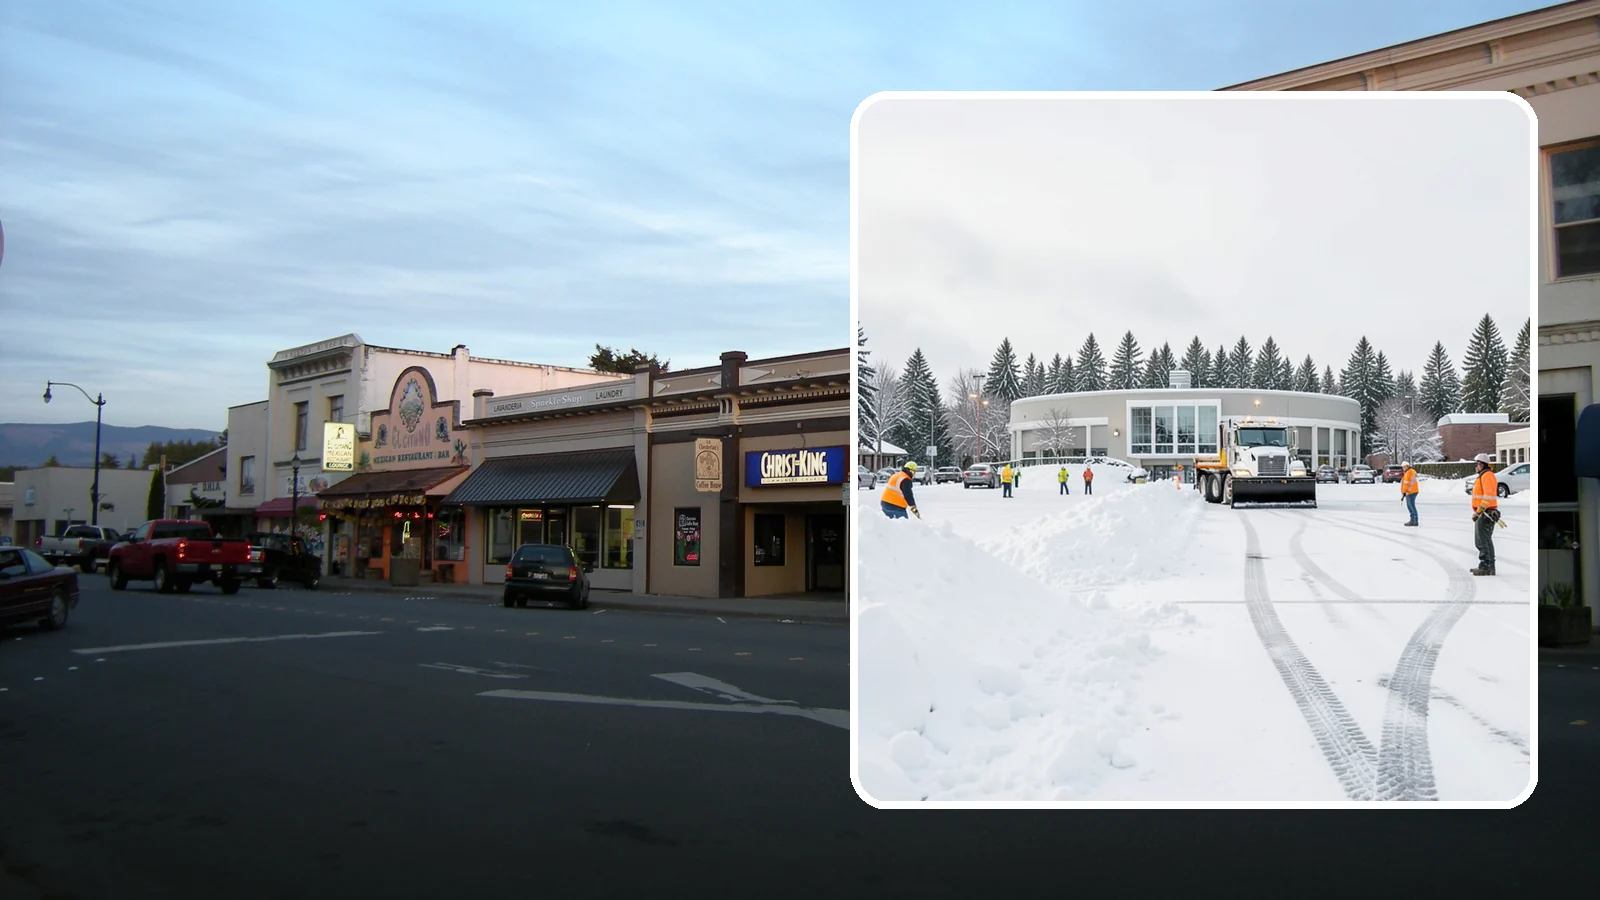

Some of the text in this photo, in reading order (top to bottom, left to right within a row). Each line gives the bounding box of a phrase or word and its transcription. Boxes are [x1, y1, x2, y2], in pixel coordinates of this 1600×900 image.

[595, 389, 624, 400] LAUNDRY
[493, 402, 522, 413] LAVANDERIA
[530, 394, 583, 410] Sparkle Shop
[373, 455, 396, 464] MEXICAN
[397, 451, 433, 462] RESTAURANT
[438, 450, 450, 459] BAR
[761, 450, 827, 478] CHRIST KING
[696, 481, 722, 489] Coffee House
